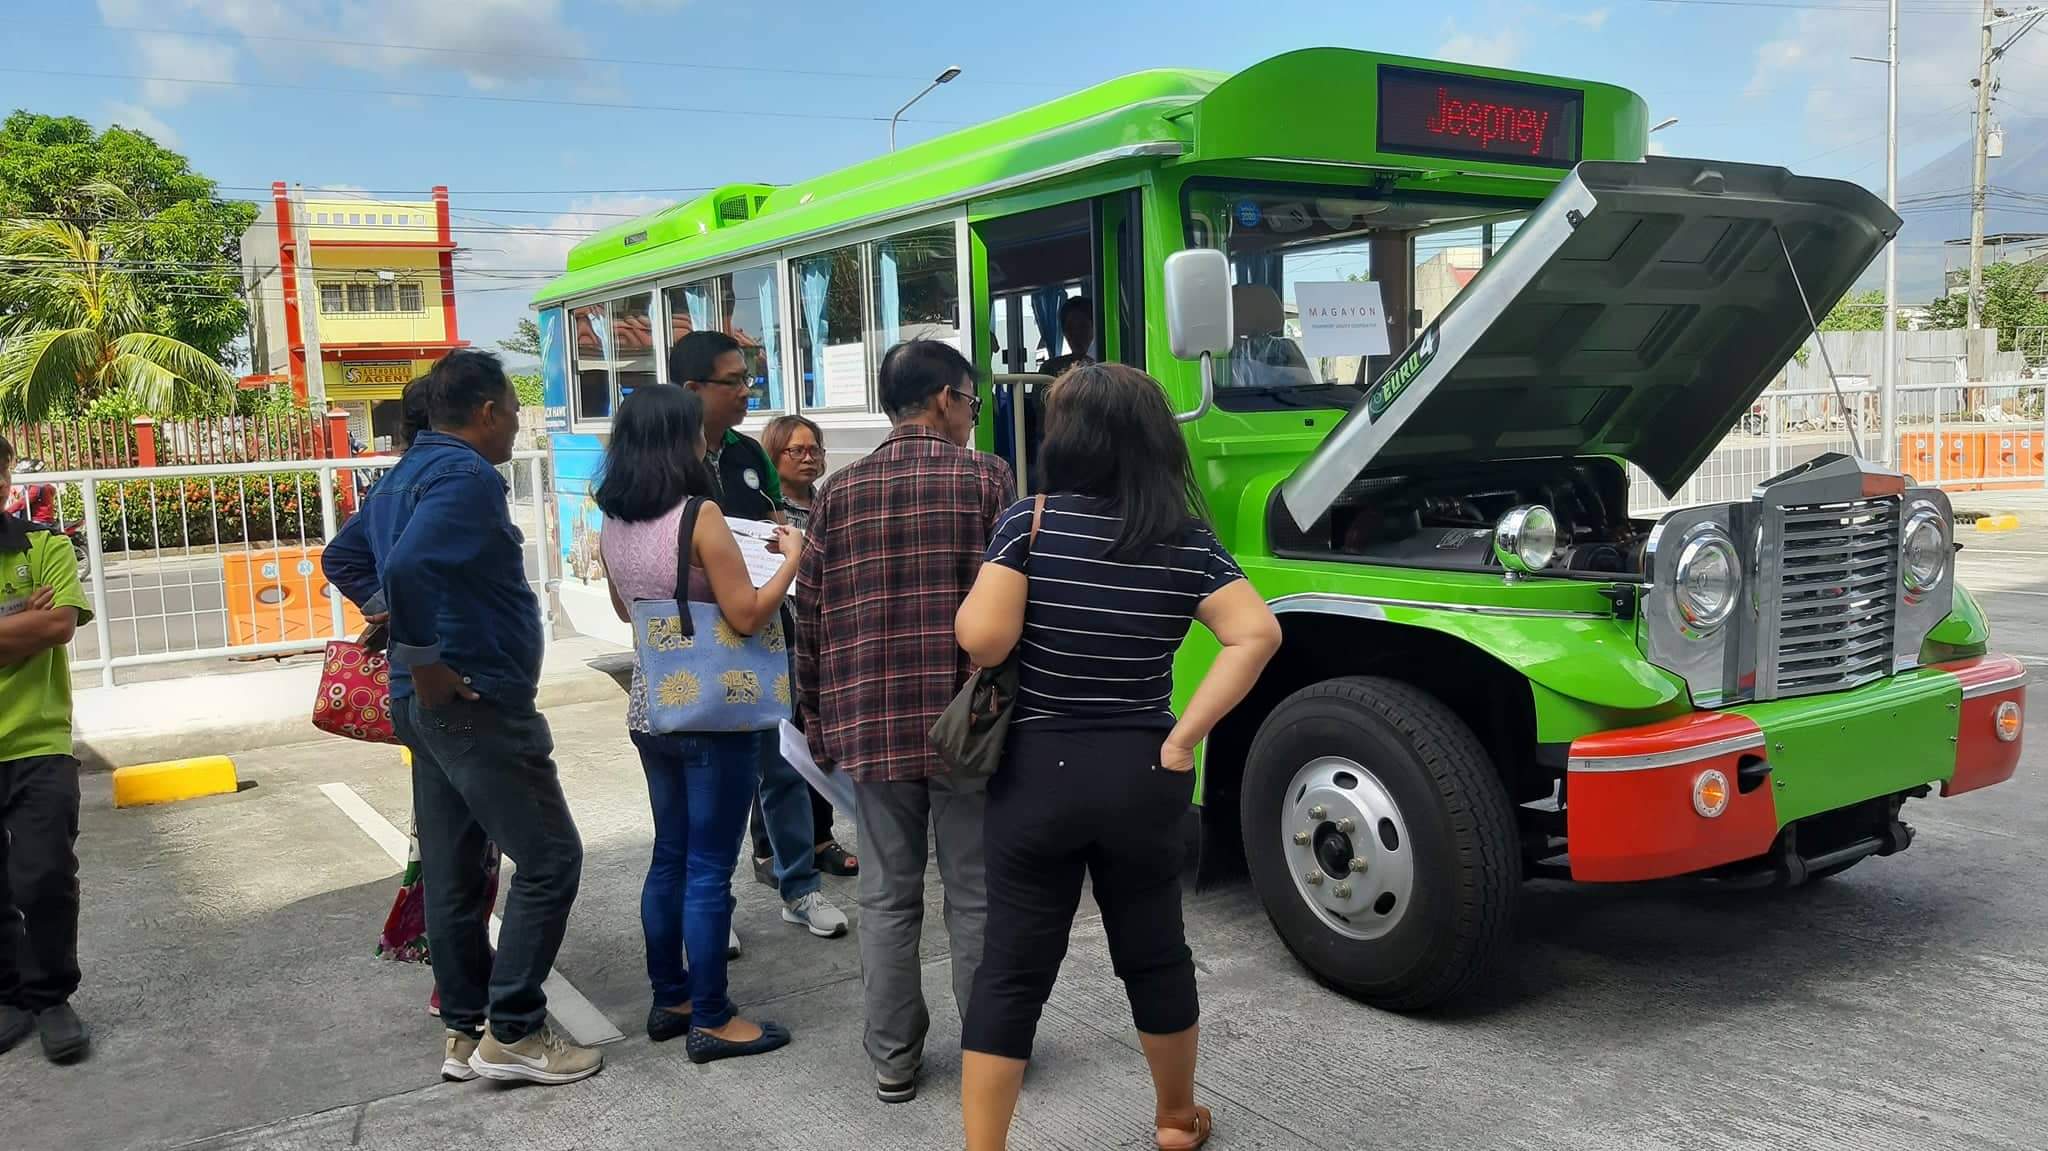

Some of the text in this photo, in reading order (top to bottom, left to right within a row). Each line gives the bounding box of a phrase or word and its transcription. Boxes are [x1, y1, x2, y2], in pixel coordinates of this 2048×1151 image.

[1426, 86, 1548, 155] Jeepney
[1308, 307, 1376, 317] MAGAYON
[365, 375, 410, 383] AGENT
[1382, 328, 1437, 402] EURO 4
